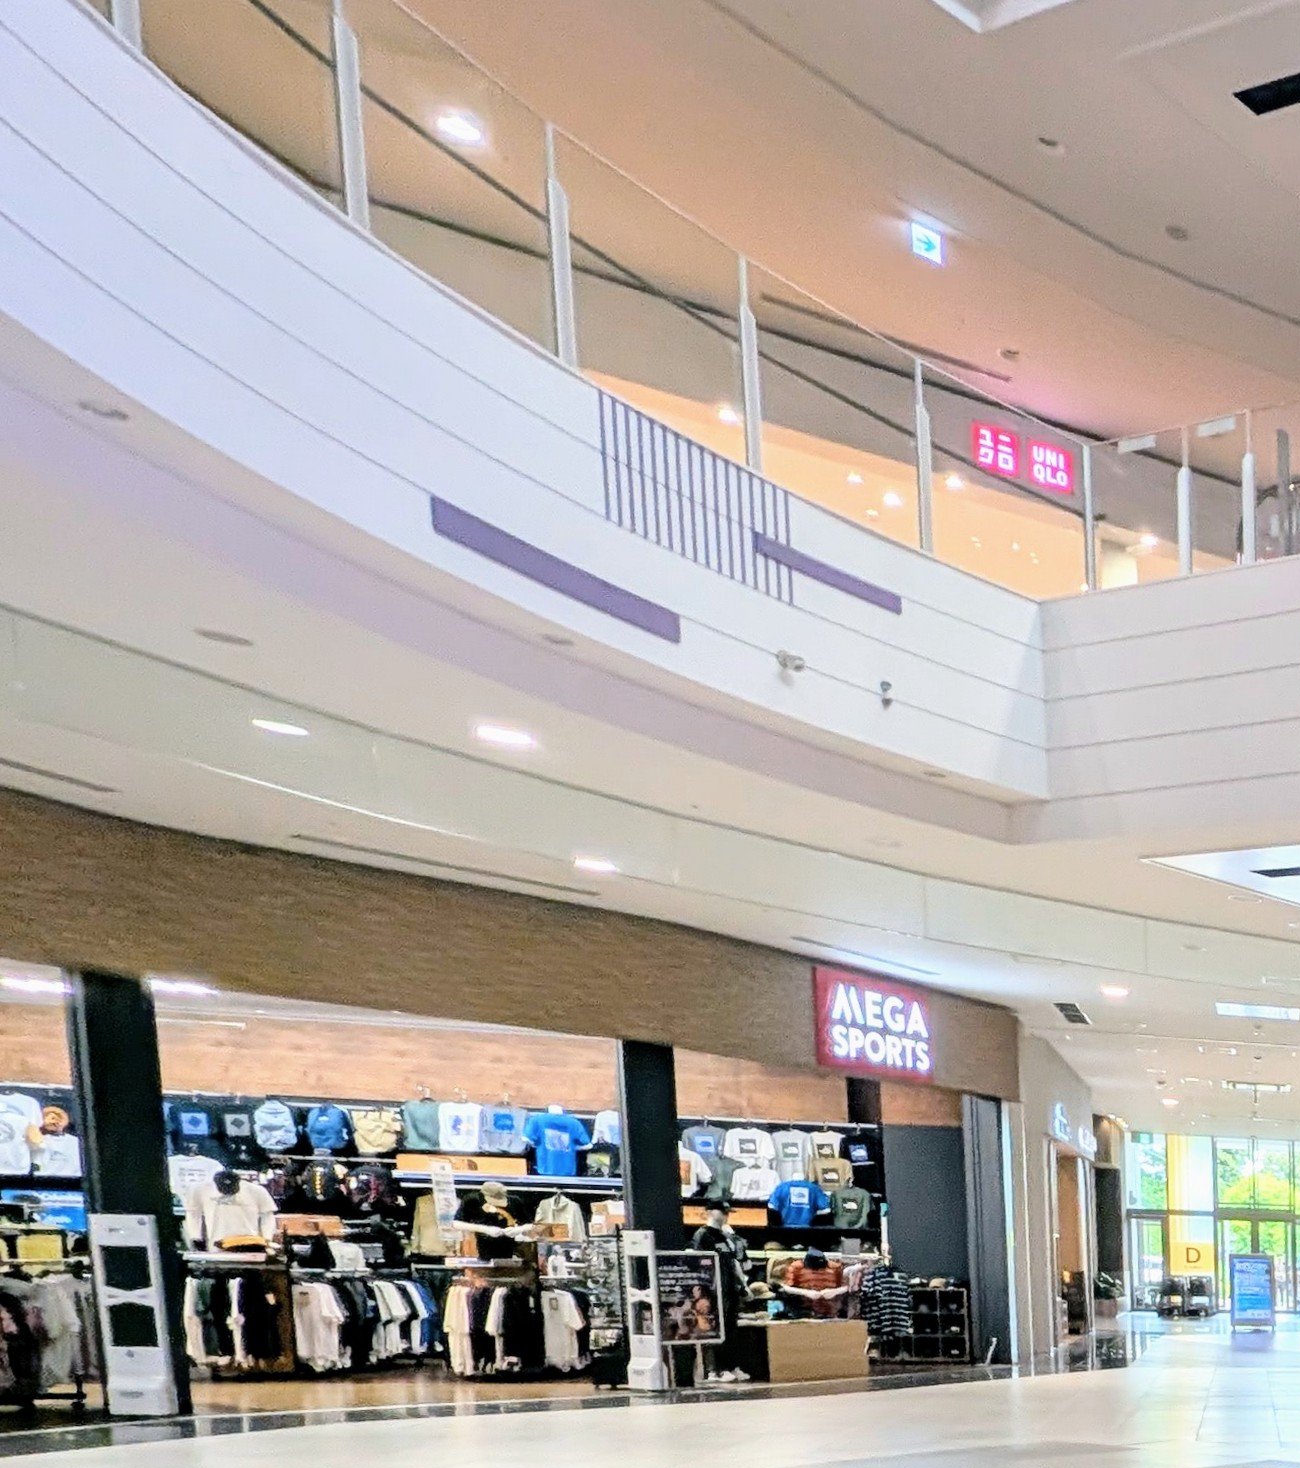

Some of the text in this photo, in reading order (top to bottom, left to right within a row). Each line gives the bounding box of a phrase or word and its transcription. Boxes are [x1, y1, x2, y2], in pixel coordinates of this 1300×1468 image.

[978, 446, 1014, 471] クロ
[1032, 444, 1066, 471] UNI
[1032, 463, 1068, 487] QLO
[831, 982, 929, 1038] MEGA
[831, 1024, 931, 1071] SPORTS
[1186, 1247, 1201, 1263] D
